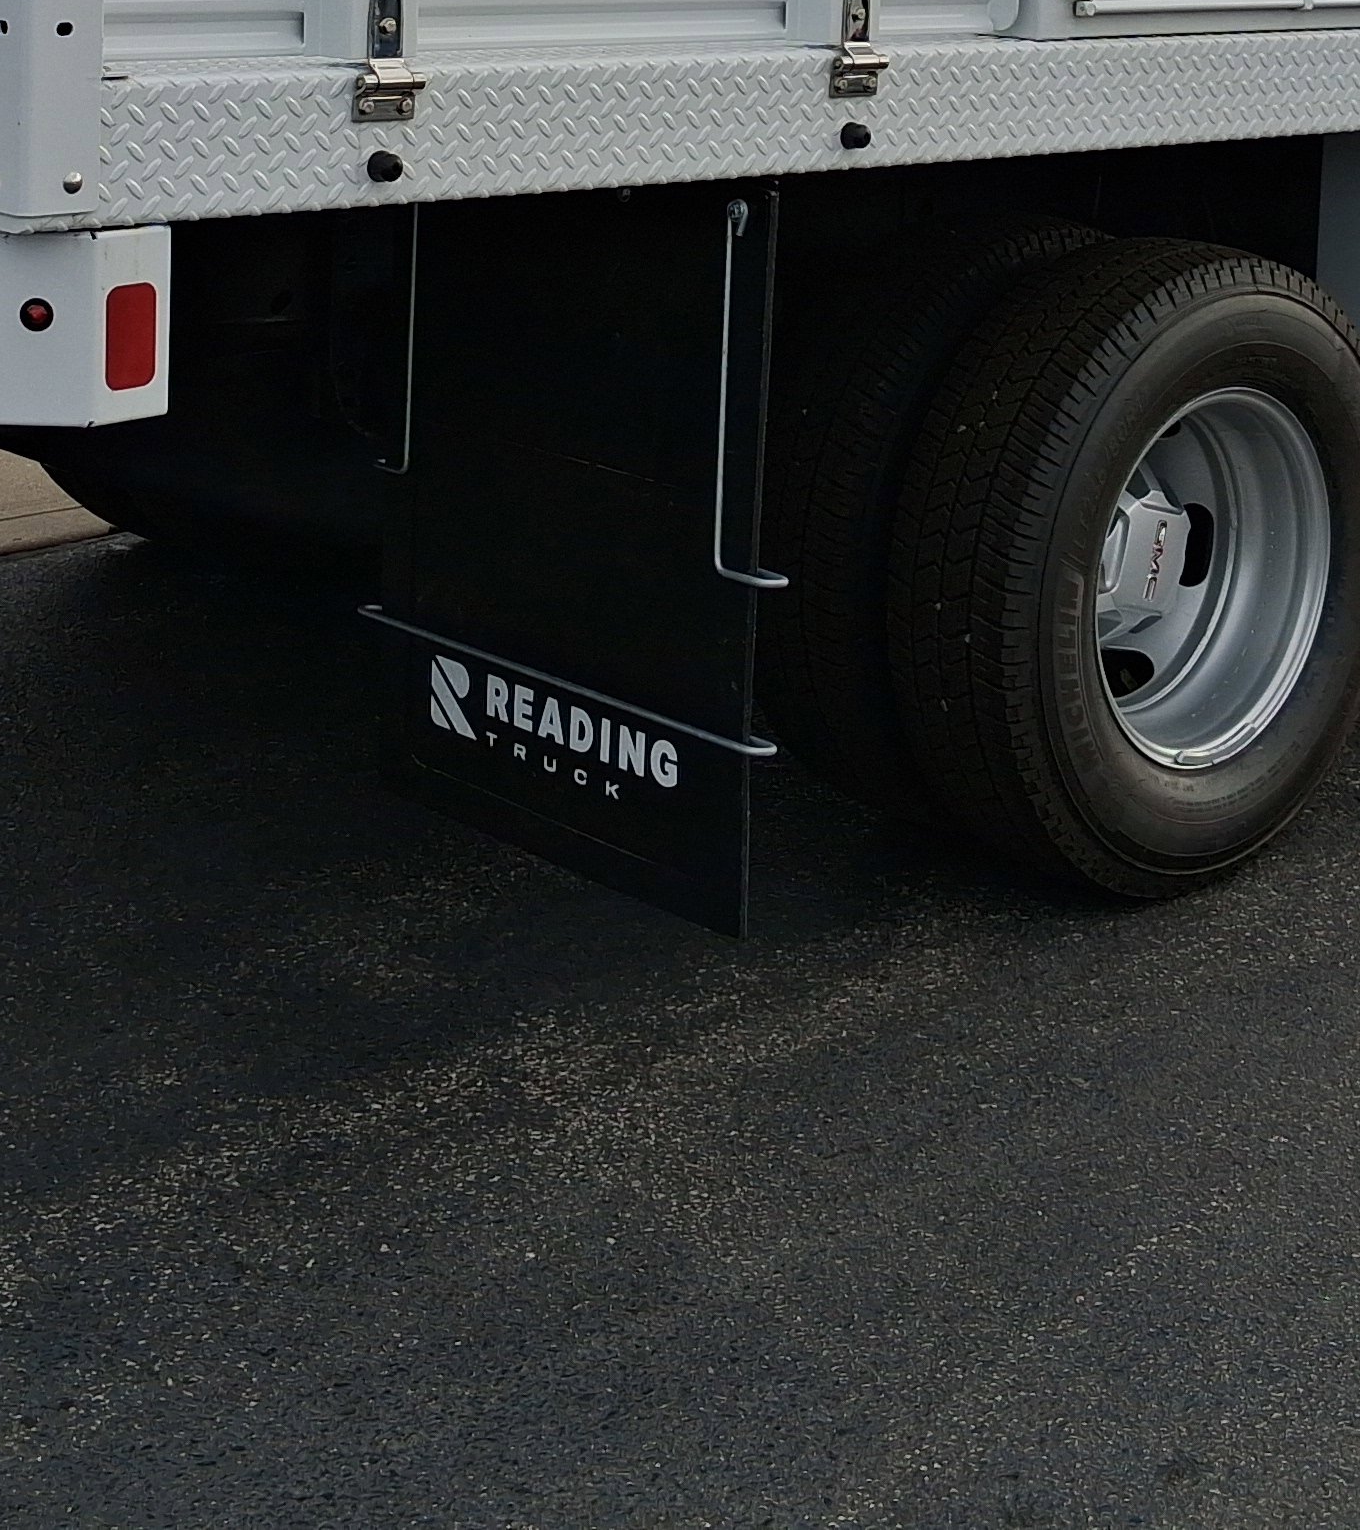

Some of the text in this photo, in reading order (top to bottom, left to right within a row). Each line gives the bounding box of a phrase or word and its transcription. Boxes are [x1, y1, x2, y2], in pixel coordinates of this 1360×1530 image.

[1142, 519, 1168, 602] GMC
[485, 730, 621, 800] TRUCK
[486, 673, 679, 788] READING
